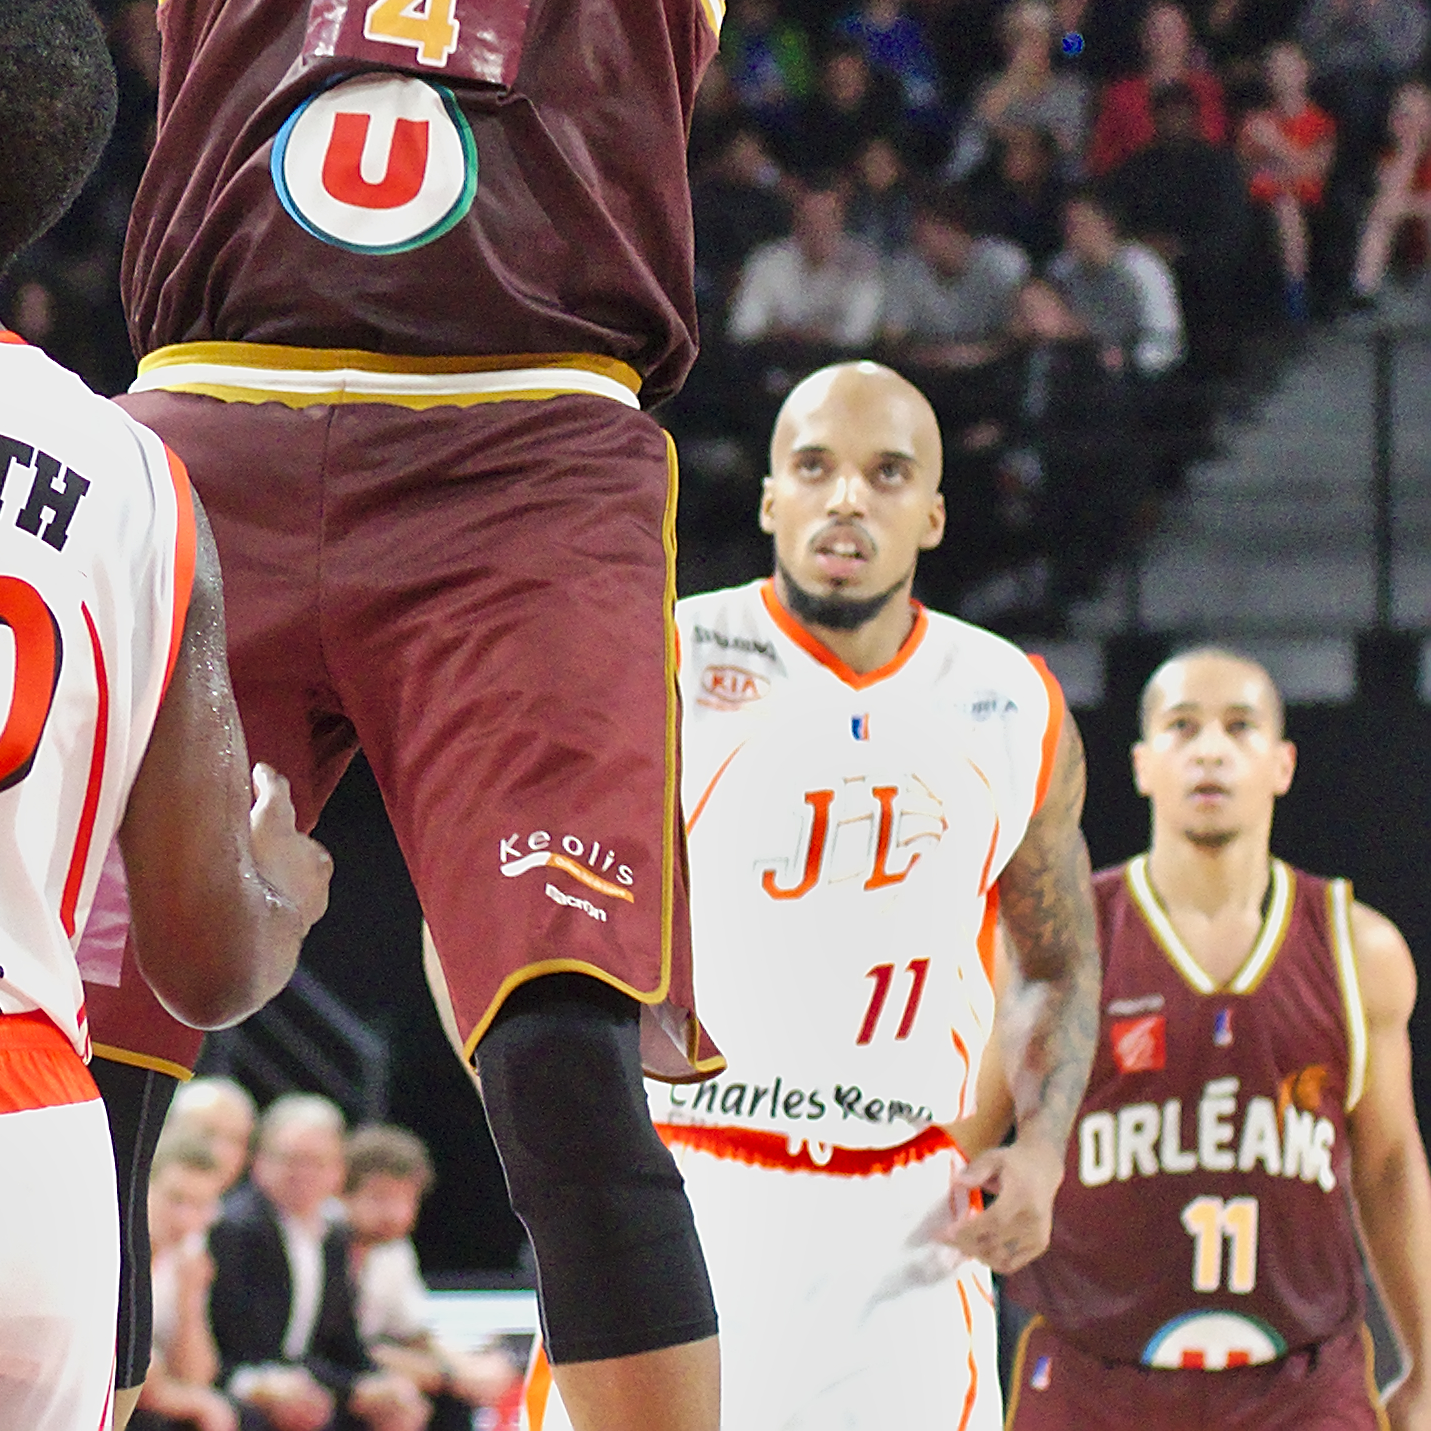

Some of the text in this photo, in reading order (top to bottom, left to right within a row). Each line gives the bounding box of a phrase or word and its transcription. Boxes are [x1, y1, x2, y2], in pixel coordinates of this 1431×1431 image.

[321, 112, 430, 210] U
[711, 674, 761, 700] KIA
[499, 830, 634, 886] Keolis
[855, 956, 931, 1046] 11
[1078, 1076, 1337, 1193] ORLÉANS
[1180, 1194, 1259, 1295] 11
